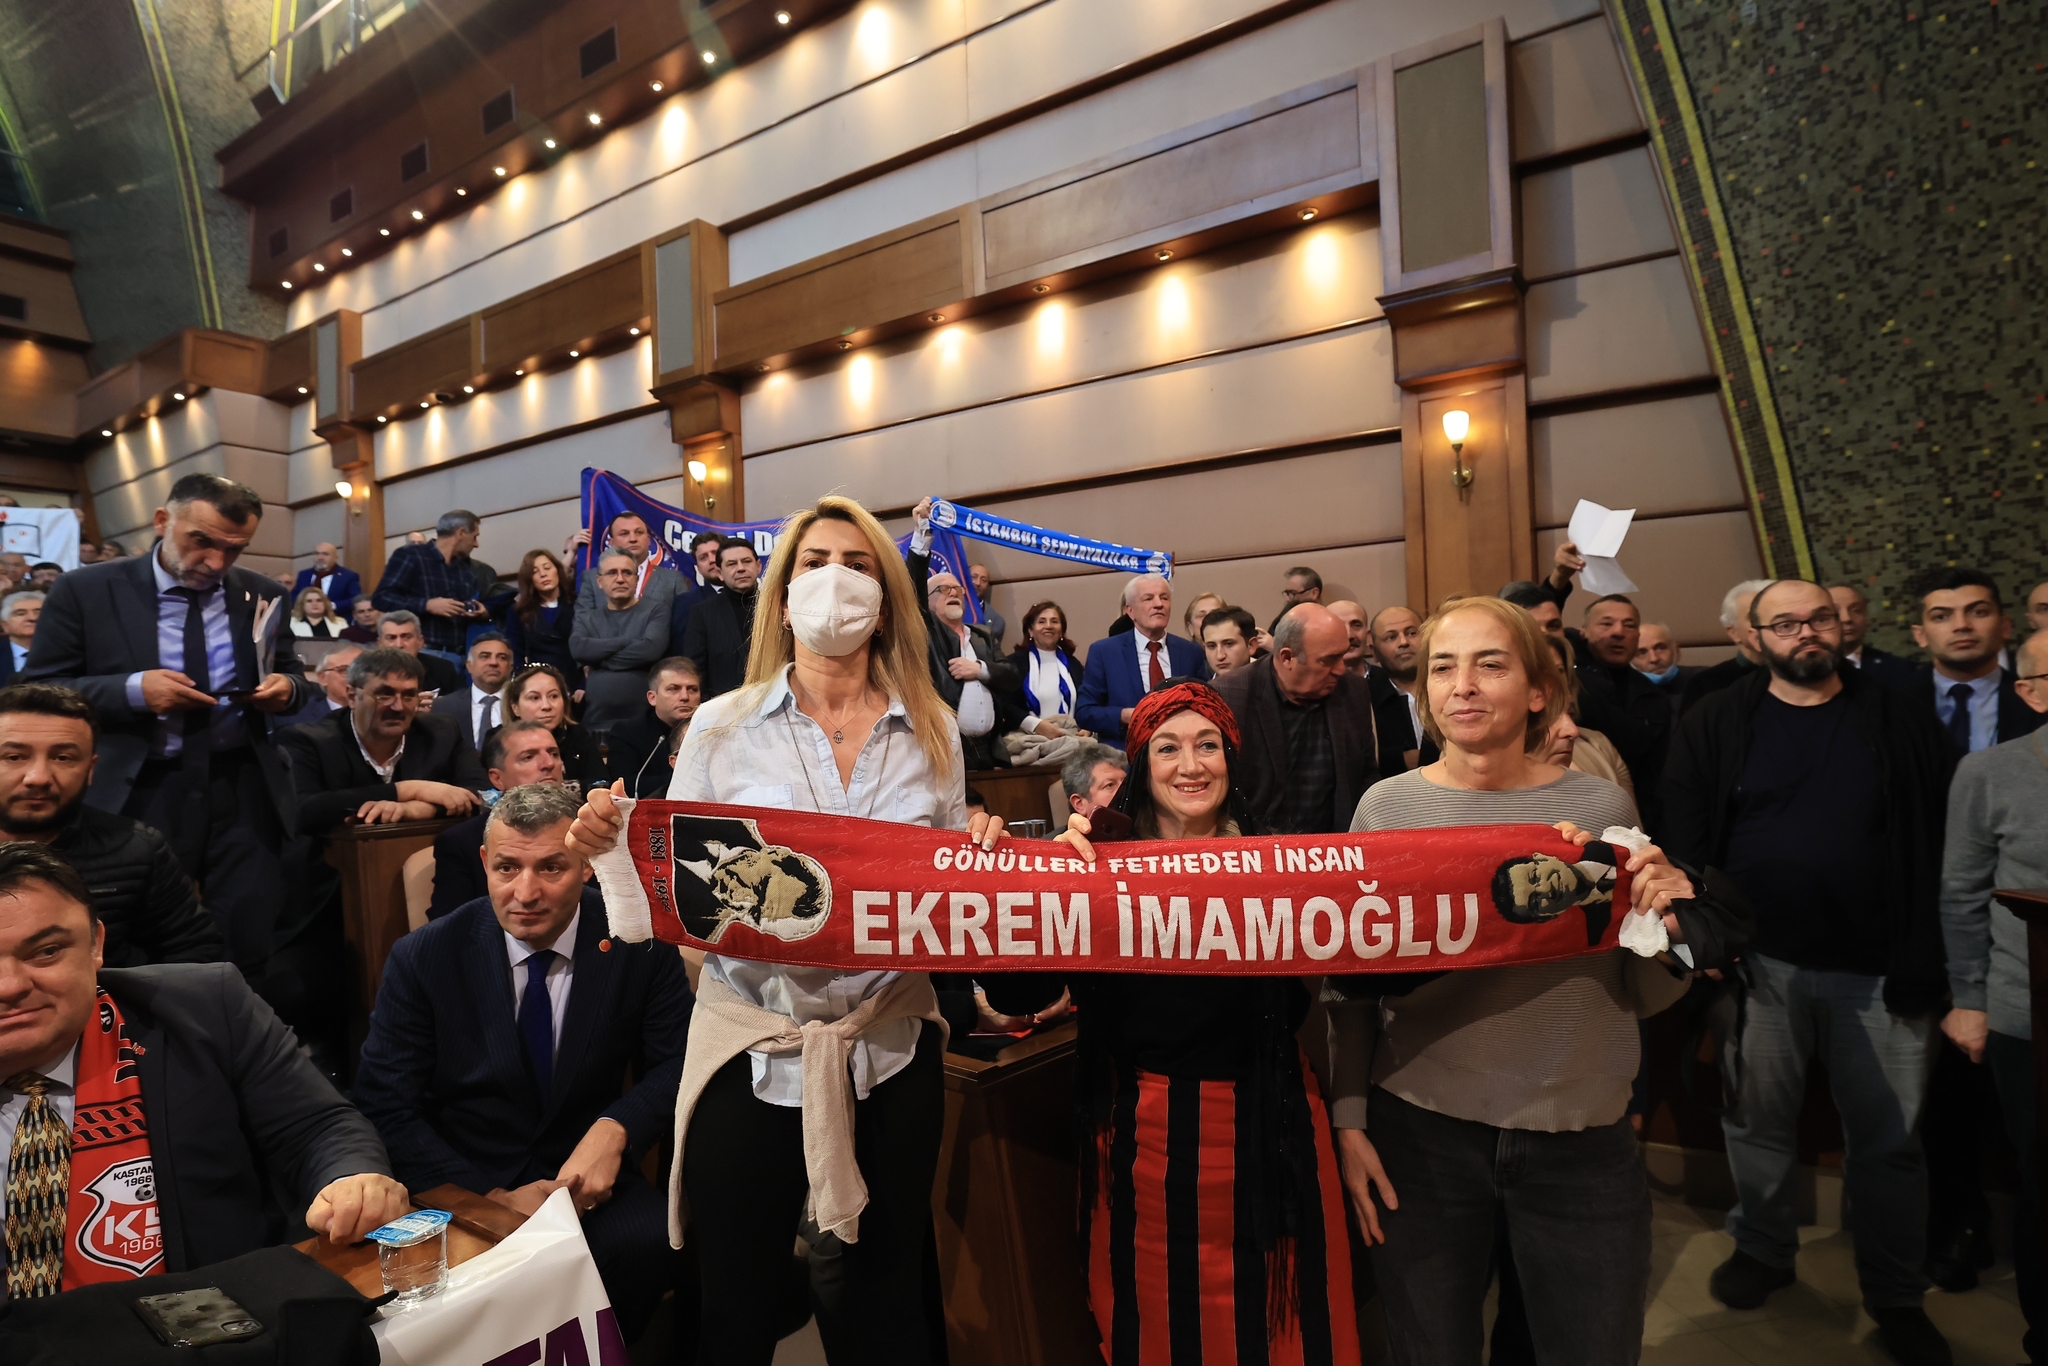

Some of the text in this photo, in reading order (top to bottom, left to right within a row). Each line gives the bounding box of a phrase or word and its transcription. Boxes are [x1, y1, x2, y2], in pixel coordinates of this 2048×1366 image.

[965, 513, 1037, 548] İSTANBUL
[649, 828, 667, 861] 1881
[1108, 850, 1262, 873] FETHEDEN
[1273, 843, 1364, 873] İNSAN
[853, 880, 1478, 961] EKREM İMAMOĞLU
[124, 1175, 152, 1187] 1966
